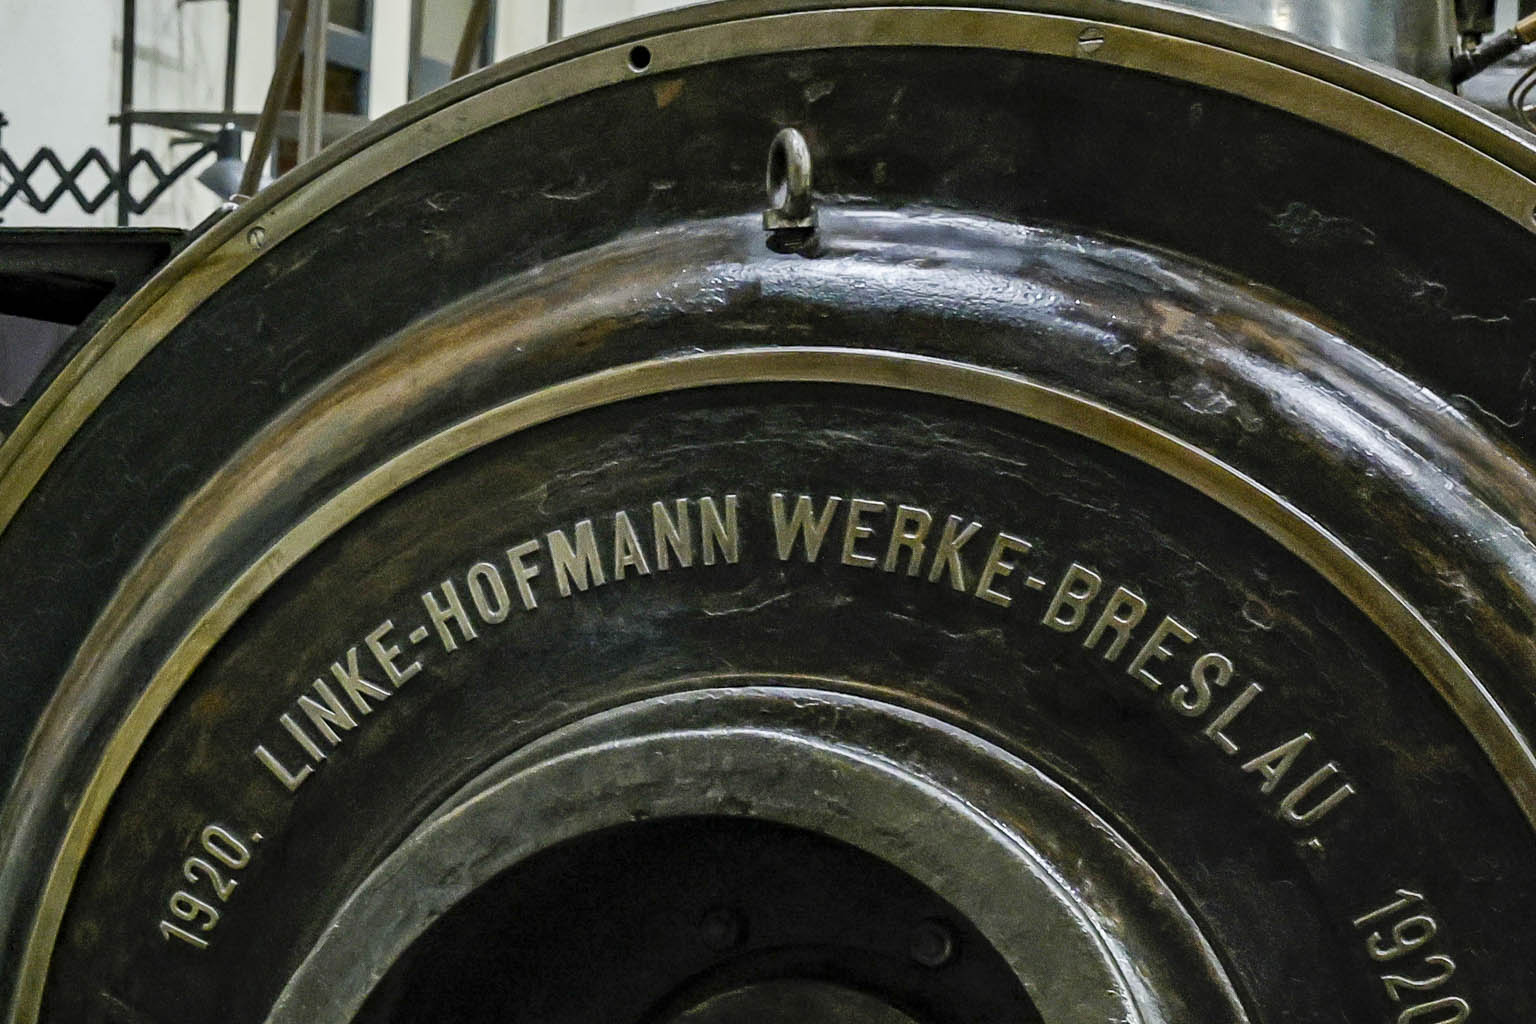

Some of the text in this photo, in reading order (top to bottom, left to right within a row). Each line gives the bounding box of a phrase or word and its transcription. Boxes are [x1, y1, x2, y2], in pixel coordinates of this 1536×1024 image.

[159, 823, 264, 950] 1920.
[253, 493, 740, 793] LINKE-HOFMANN
[771, 491, 1357, 855] WERKE-BRESLAU.
